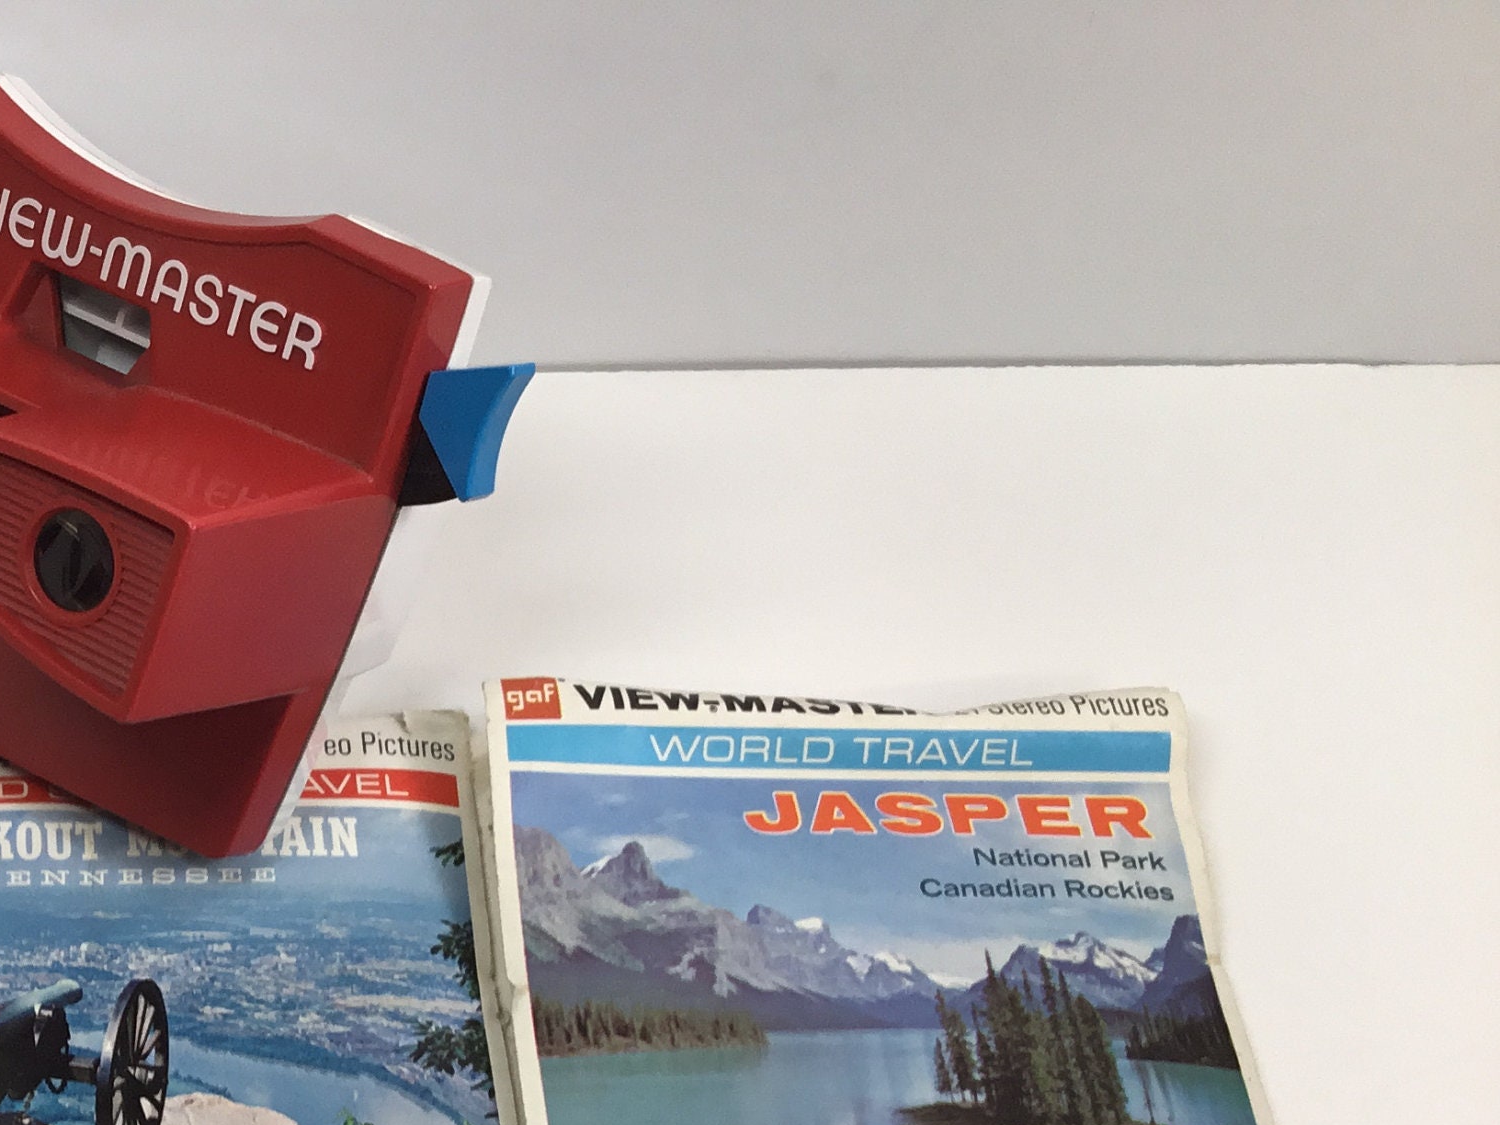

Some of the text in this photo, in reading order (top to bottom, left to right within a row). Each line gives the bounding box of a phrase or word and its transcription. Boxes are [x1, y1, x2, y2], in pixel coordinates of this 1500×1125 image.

[507, 682, 556, 712] gaf
[1069, 695, 1169, 717] Pictures
[361, 731, 455, 762] Pictures
[649, 734, 1033, 766] WORLD TRAVEL
[304, 773, 409, 797] AVEL
[743, 790, 1154, 839] JASPER
[973, 847, 1167, 872] National Park
[920, 877, 1175, 902] Canadian Rockies
